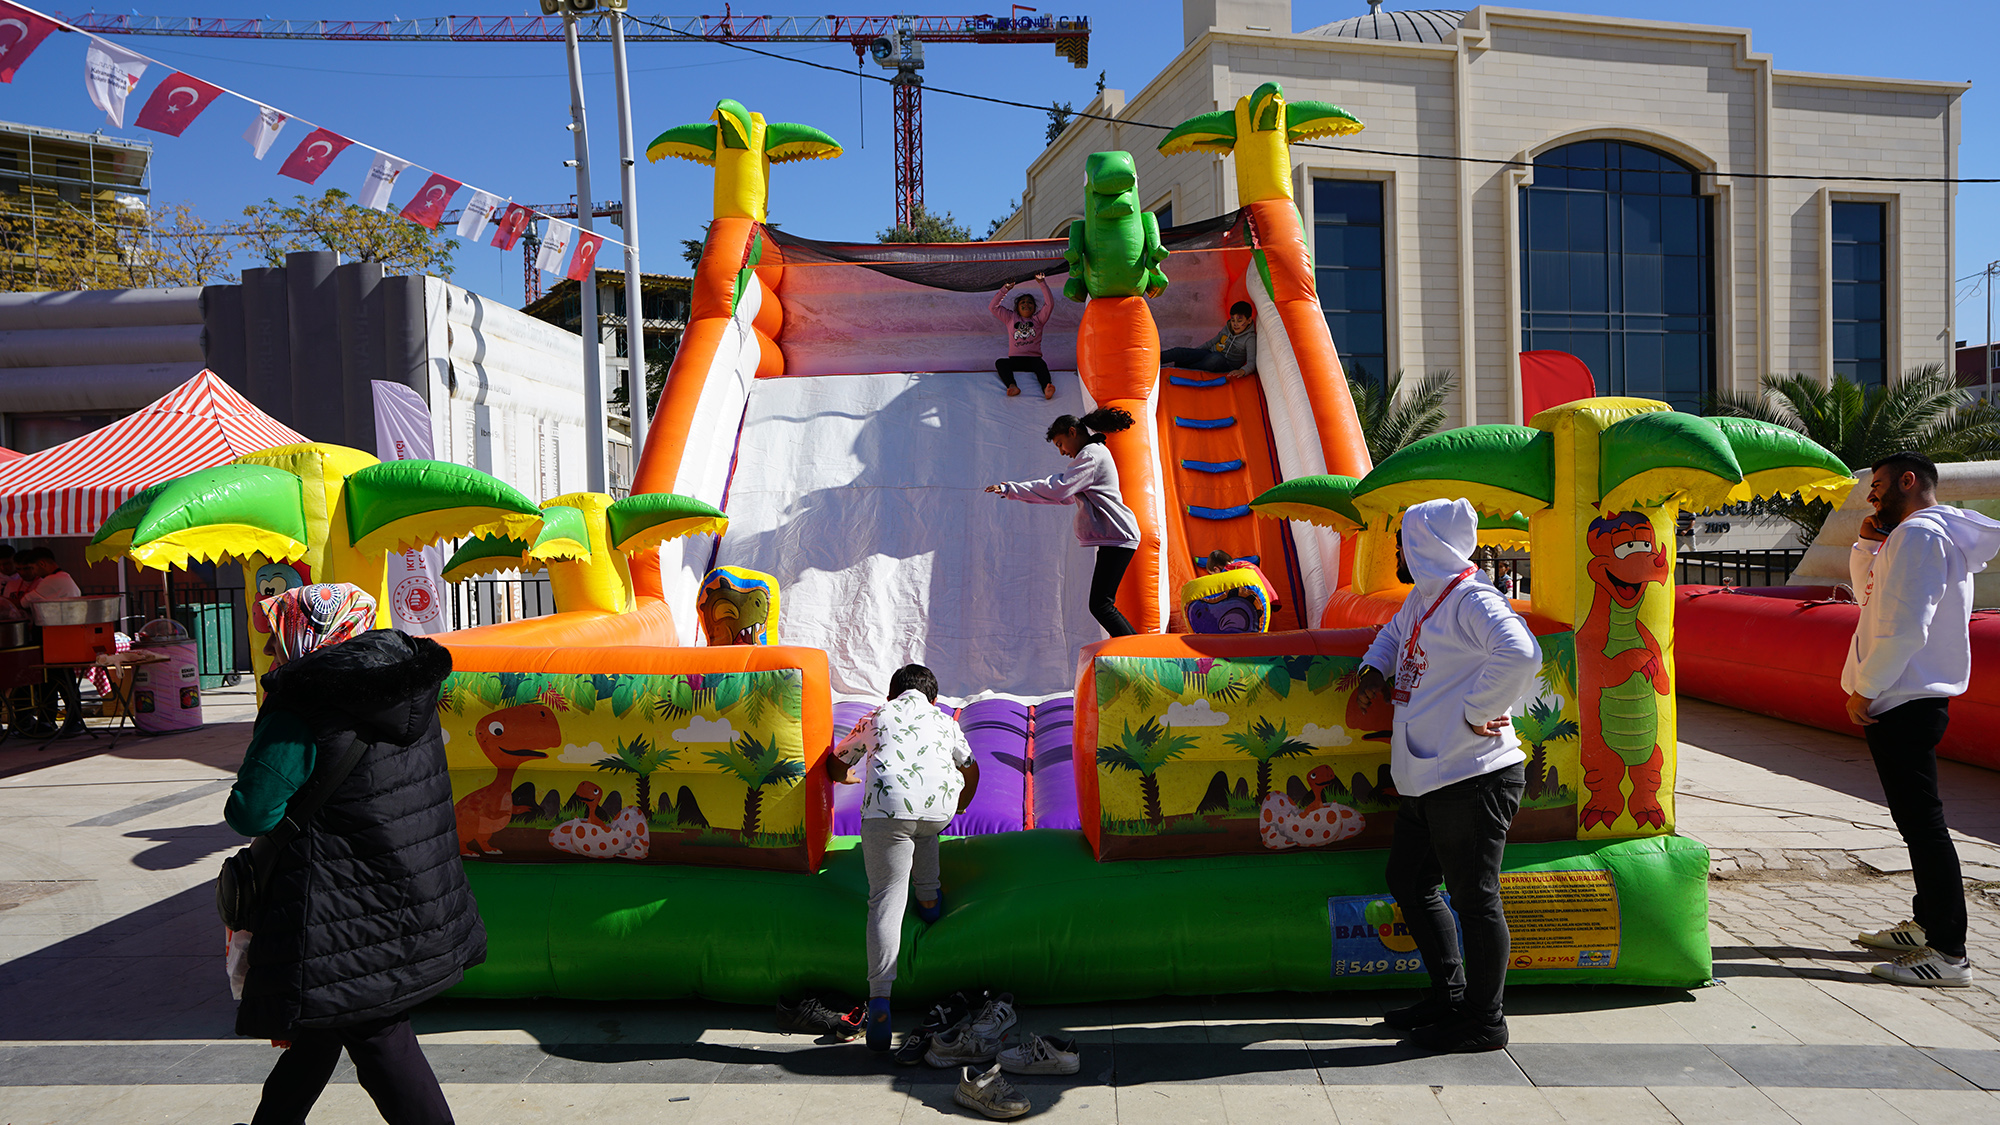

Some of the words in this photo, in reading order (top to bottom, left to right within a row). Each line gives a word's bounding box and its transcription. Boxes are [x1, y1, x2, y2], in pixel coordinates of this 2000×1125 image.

[1705, 522, 1730, 534] 2019
[1336, 922, 1410, 939] BALOR
[1348, 960, 1389, 974] 549
[1394, 958, 1421, 972] 89
